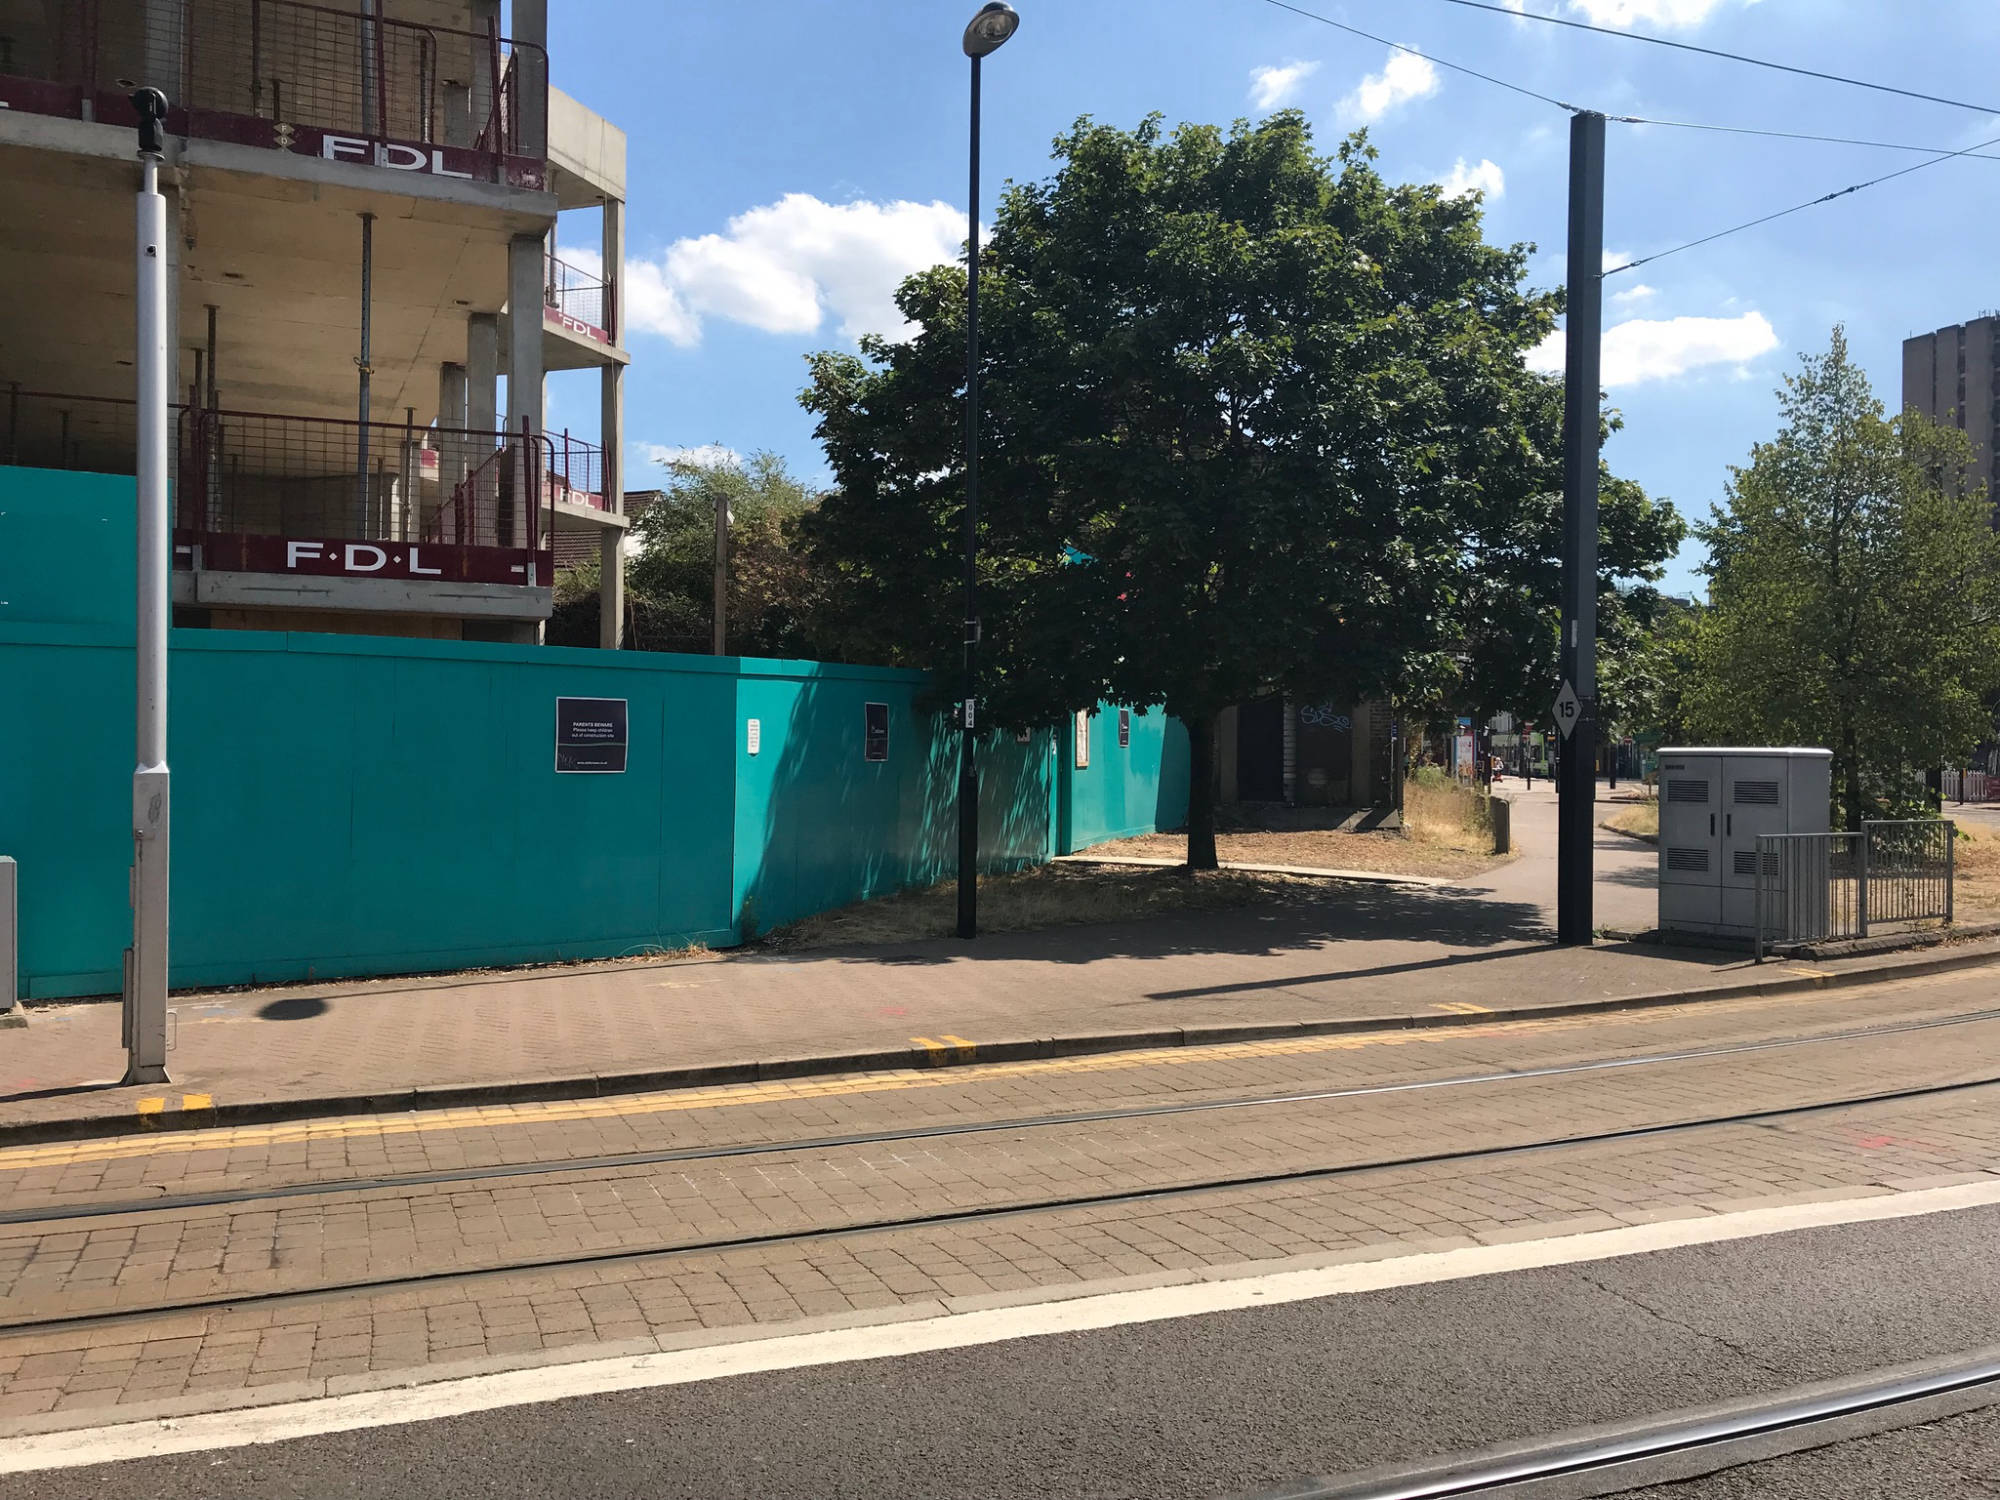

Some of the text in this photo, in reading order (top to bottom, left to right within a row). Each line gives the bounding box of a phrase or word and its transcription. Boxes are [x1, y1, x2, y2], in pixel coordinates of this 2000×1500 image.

[322, 134, 473, 179] FDL
[562, 316, 597, 340] FDL
[560, 487, 594, 508] FDL
[1559, 701, 1575, 718] 15
